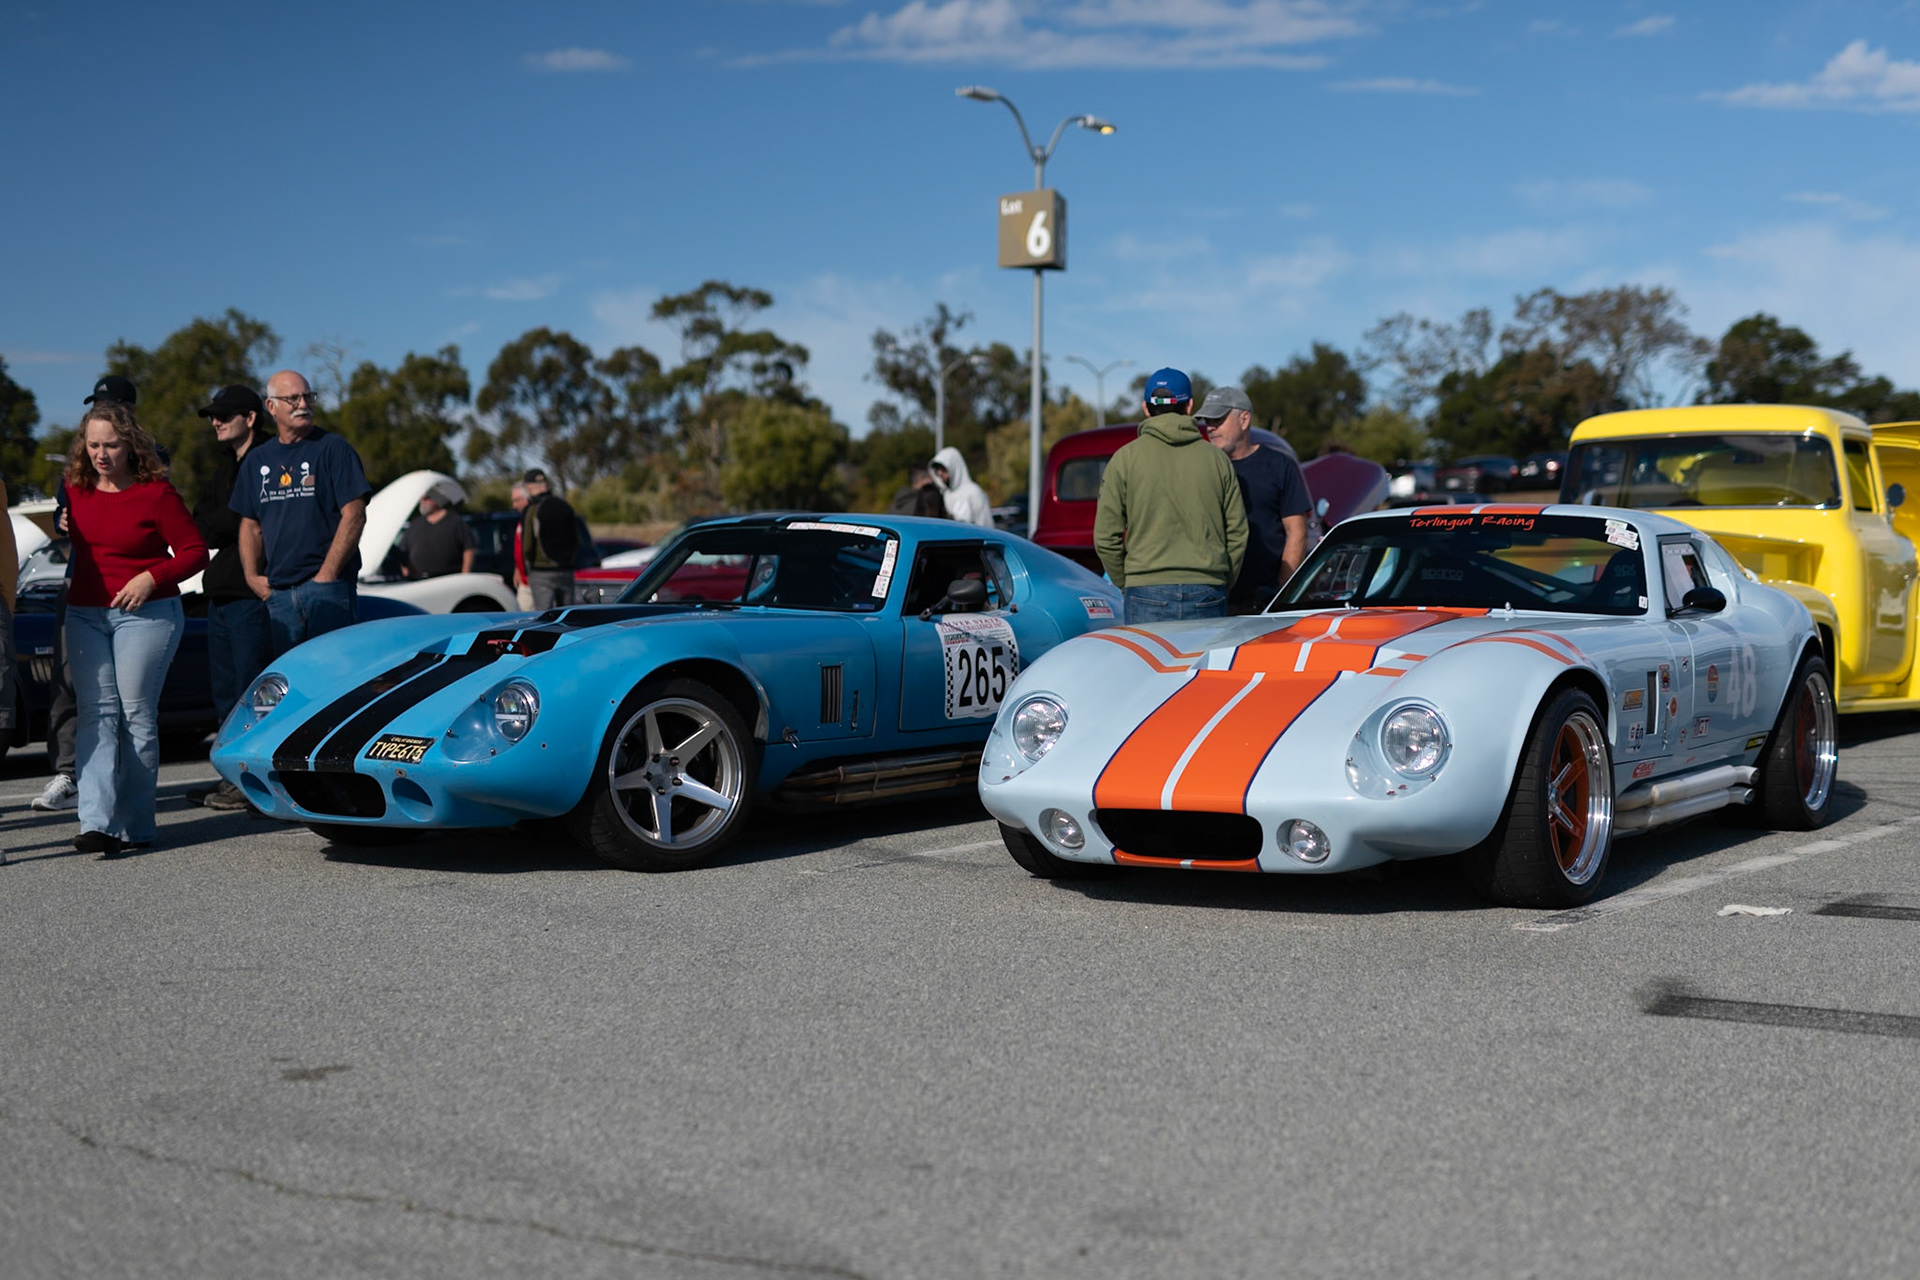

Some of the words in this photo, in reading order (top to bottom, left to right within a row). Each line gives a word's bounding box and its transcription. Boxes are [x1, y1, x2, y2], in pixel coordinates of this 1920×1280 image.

[1026, 210, 1051, 258] 6
[1410, 515, 1474, 531] Terlingua
[1481, 514, 1536, 531] Racing
[958, 646, 1006, 708] 265
[1726, 643, 1757, 720] 48
[391, 736, 422, 744] CALIFORNIA
